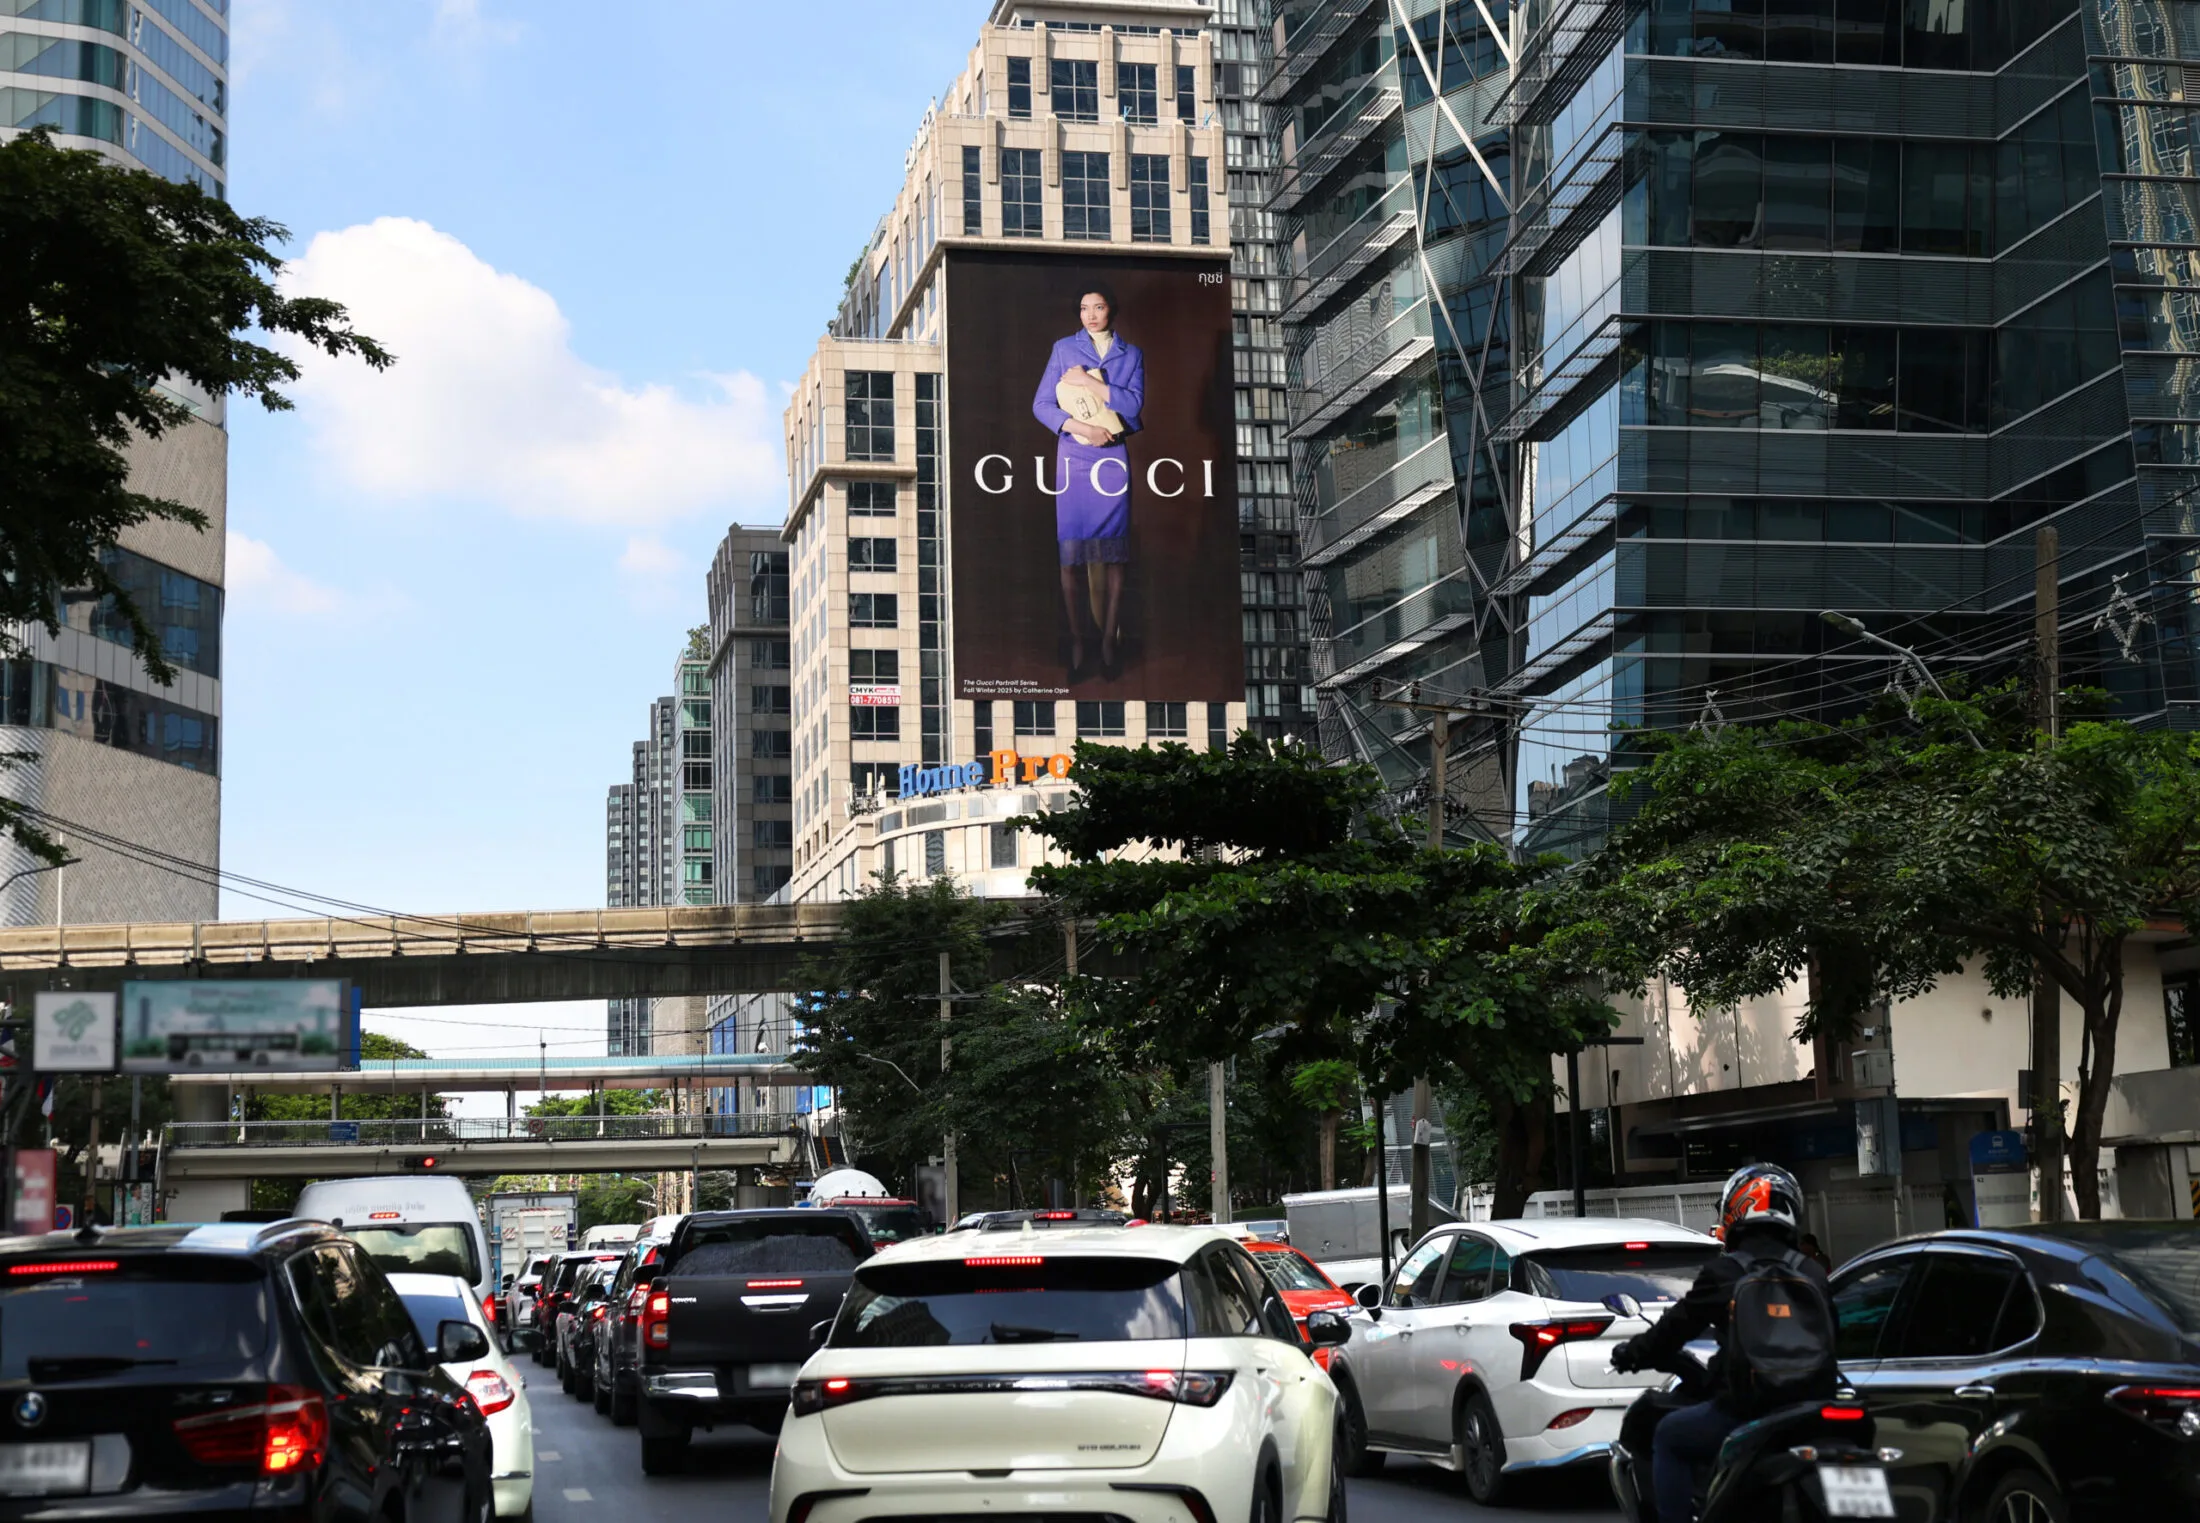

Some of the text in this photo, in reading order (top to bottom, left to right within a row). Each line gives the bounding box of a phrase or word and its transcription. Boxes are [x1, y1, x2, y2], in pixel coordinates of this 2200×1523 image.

[1198, 268, 1223, 286] กุชชี่
[974, 453, 1215, 498] GUCCI
[1013, 687, 1021, 695] by
[1054, 687, 1070, 695] Opie
[898, 749, 1072, 800] Home Pro
